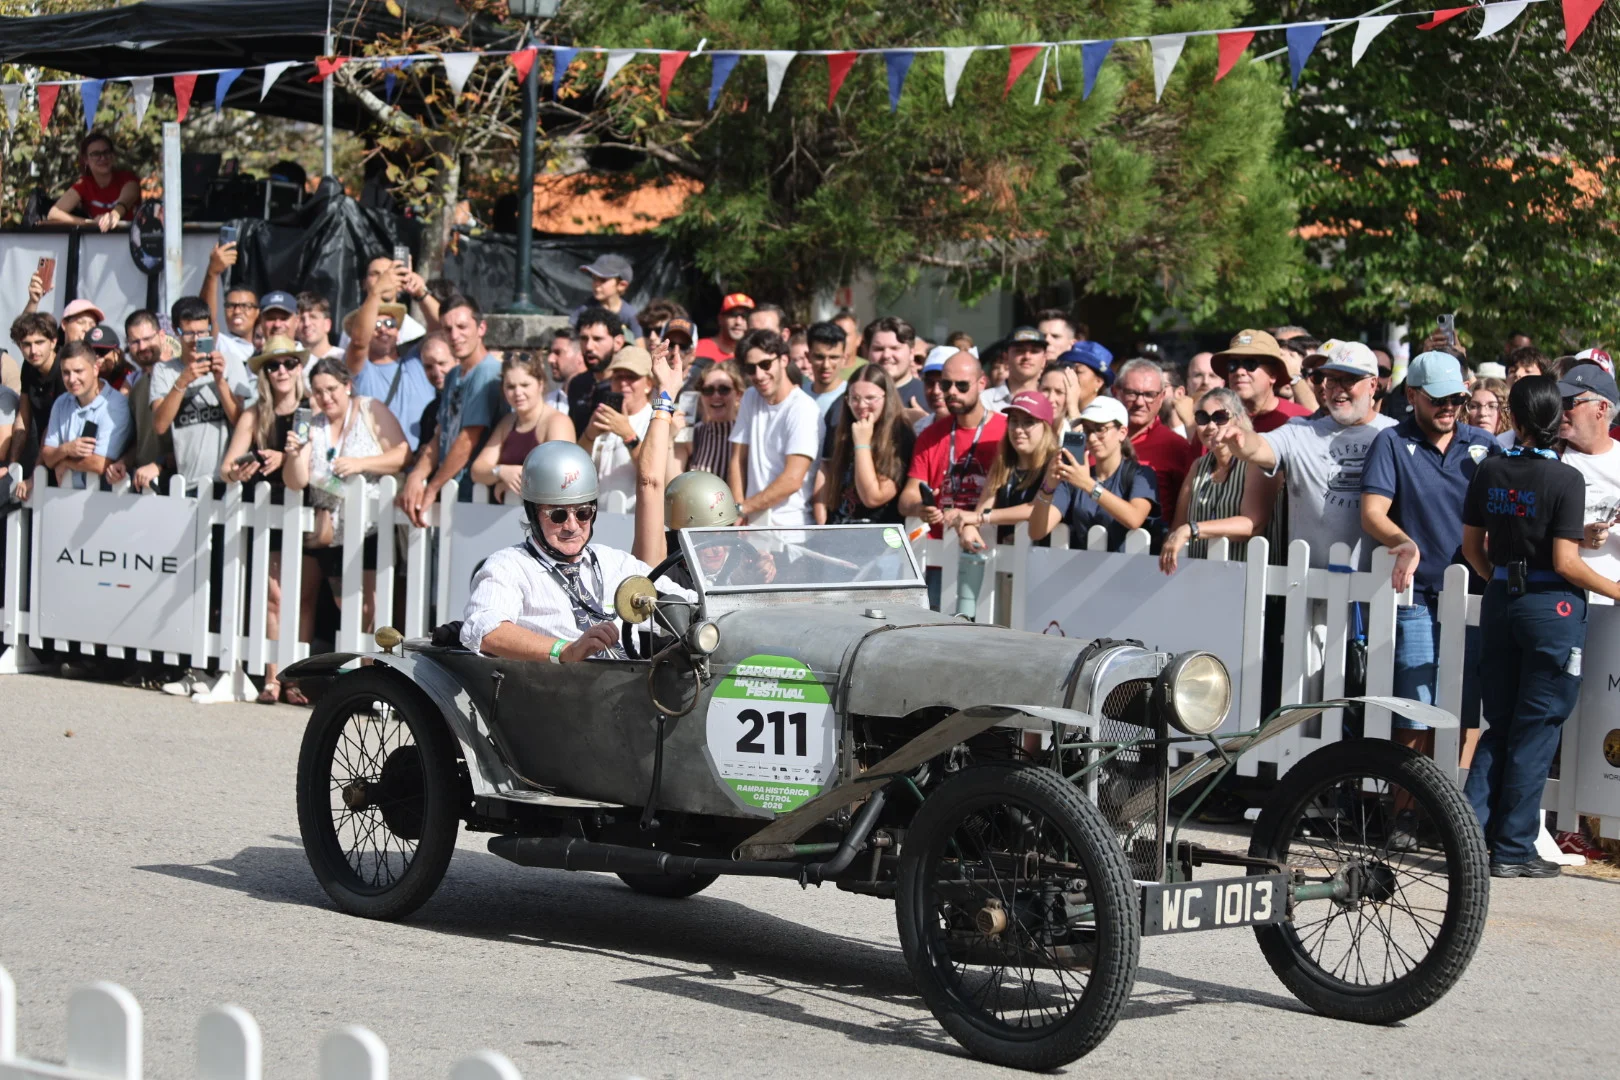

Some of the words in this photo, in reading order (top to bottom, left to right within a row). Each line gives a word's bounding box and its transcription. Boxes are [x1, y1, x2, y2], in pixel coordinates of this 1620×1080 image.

[1320, 443, 1368, 459] OLFSB
[1488, 487, 1536, 505] STRONG
[1487, 501, 1536, 518] CHARON
[56, 547, 178, 574] ALPINE
[736, 664, 806, 680] CARAMULO
[734, 677, 778, 688] MOTOR
[745, 687, 804, 699] FESTIVAL
[736, 709, 807, 757] 211
[1603, 772, 1620, 782] WOR
[736, 784, 765, 794] RAMPA
[765, 785, 810, 797] HISTÓRICA
[753, 793, 792, 803] CASTROL
[761, 801, 783, 810] 2026
[1162, 887, 1203, 931] WC
[1214, 880, 1273, 925] 1013
